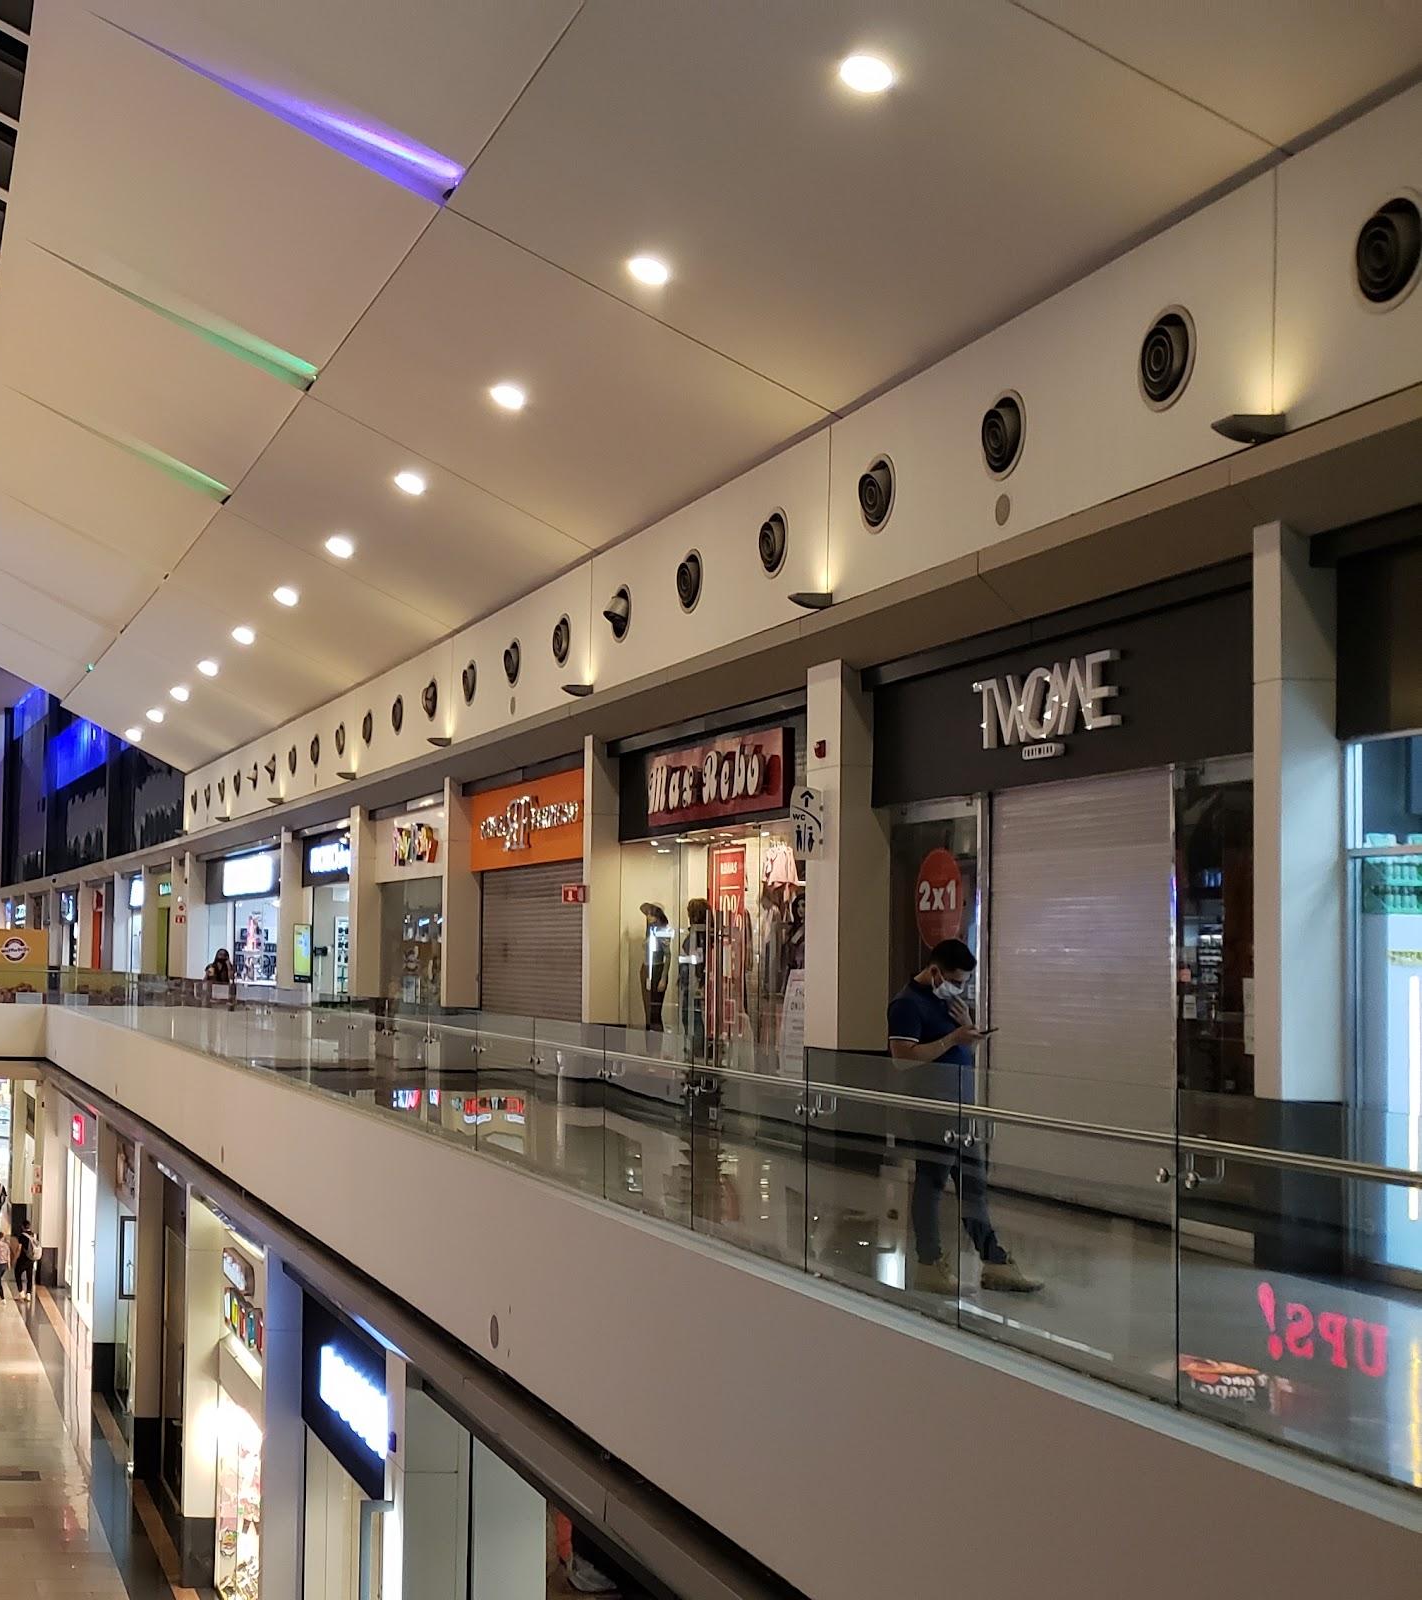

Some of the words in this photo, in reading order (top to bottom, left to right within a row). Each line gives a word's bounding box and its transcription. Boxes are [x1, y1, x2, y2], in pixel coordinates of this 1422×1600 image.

[702, 743, 766, 805] Rebo
[792, 813, 806, 821] WC
[919, 880, 956, 911] 2x1
